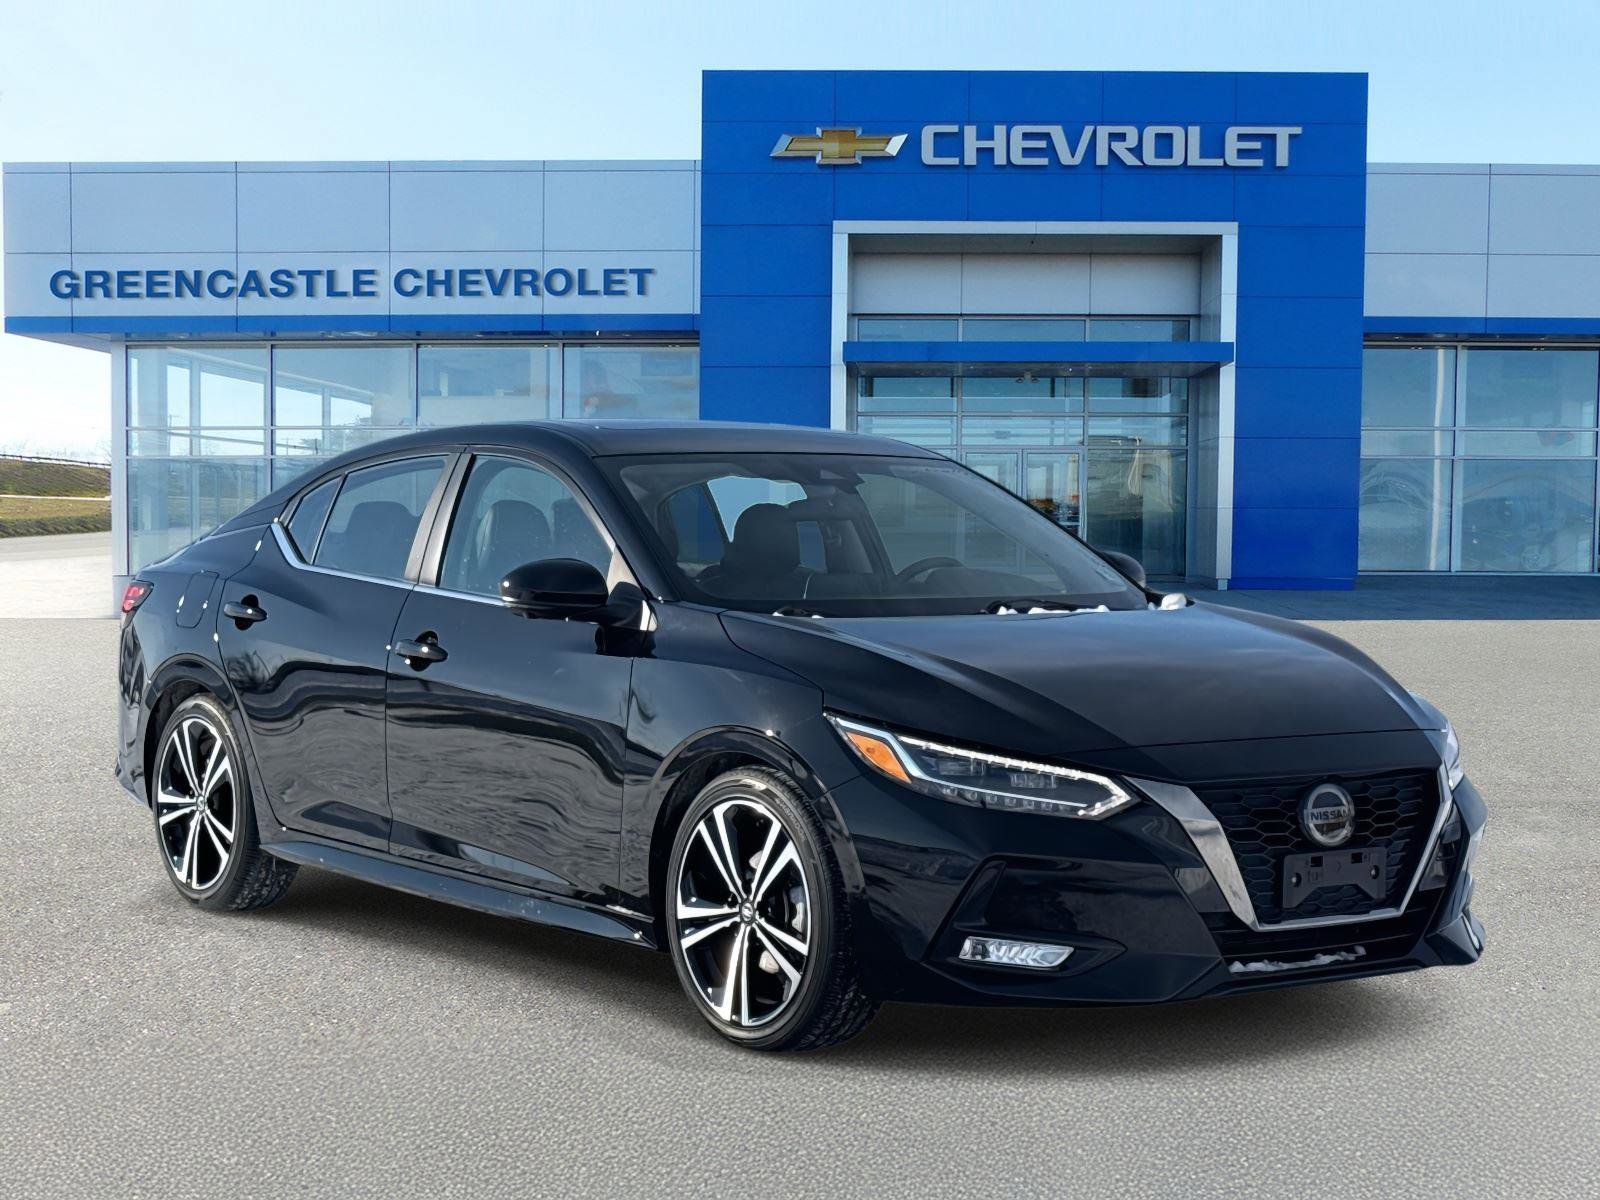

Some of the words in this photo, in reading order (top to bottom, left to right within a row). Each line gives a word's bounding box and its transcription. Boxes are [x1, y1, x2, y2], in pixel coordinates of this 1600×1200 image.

[921, 125, 1303, 168] CHEVROLET
[50, 269, 377, 299] GREENCASTLE
[394, 268, 656, 297] CHEVROLET
[1310, 808, 1348, 820] NISSAN
